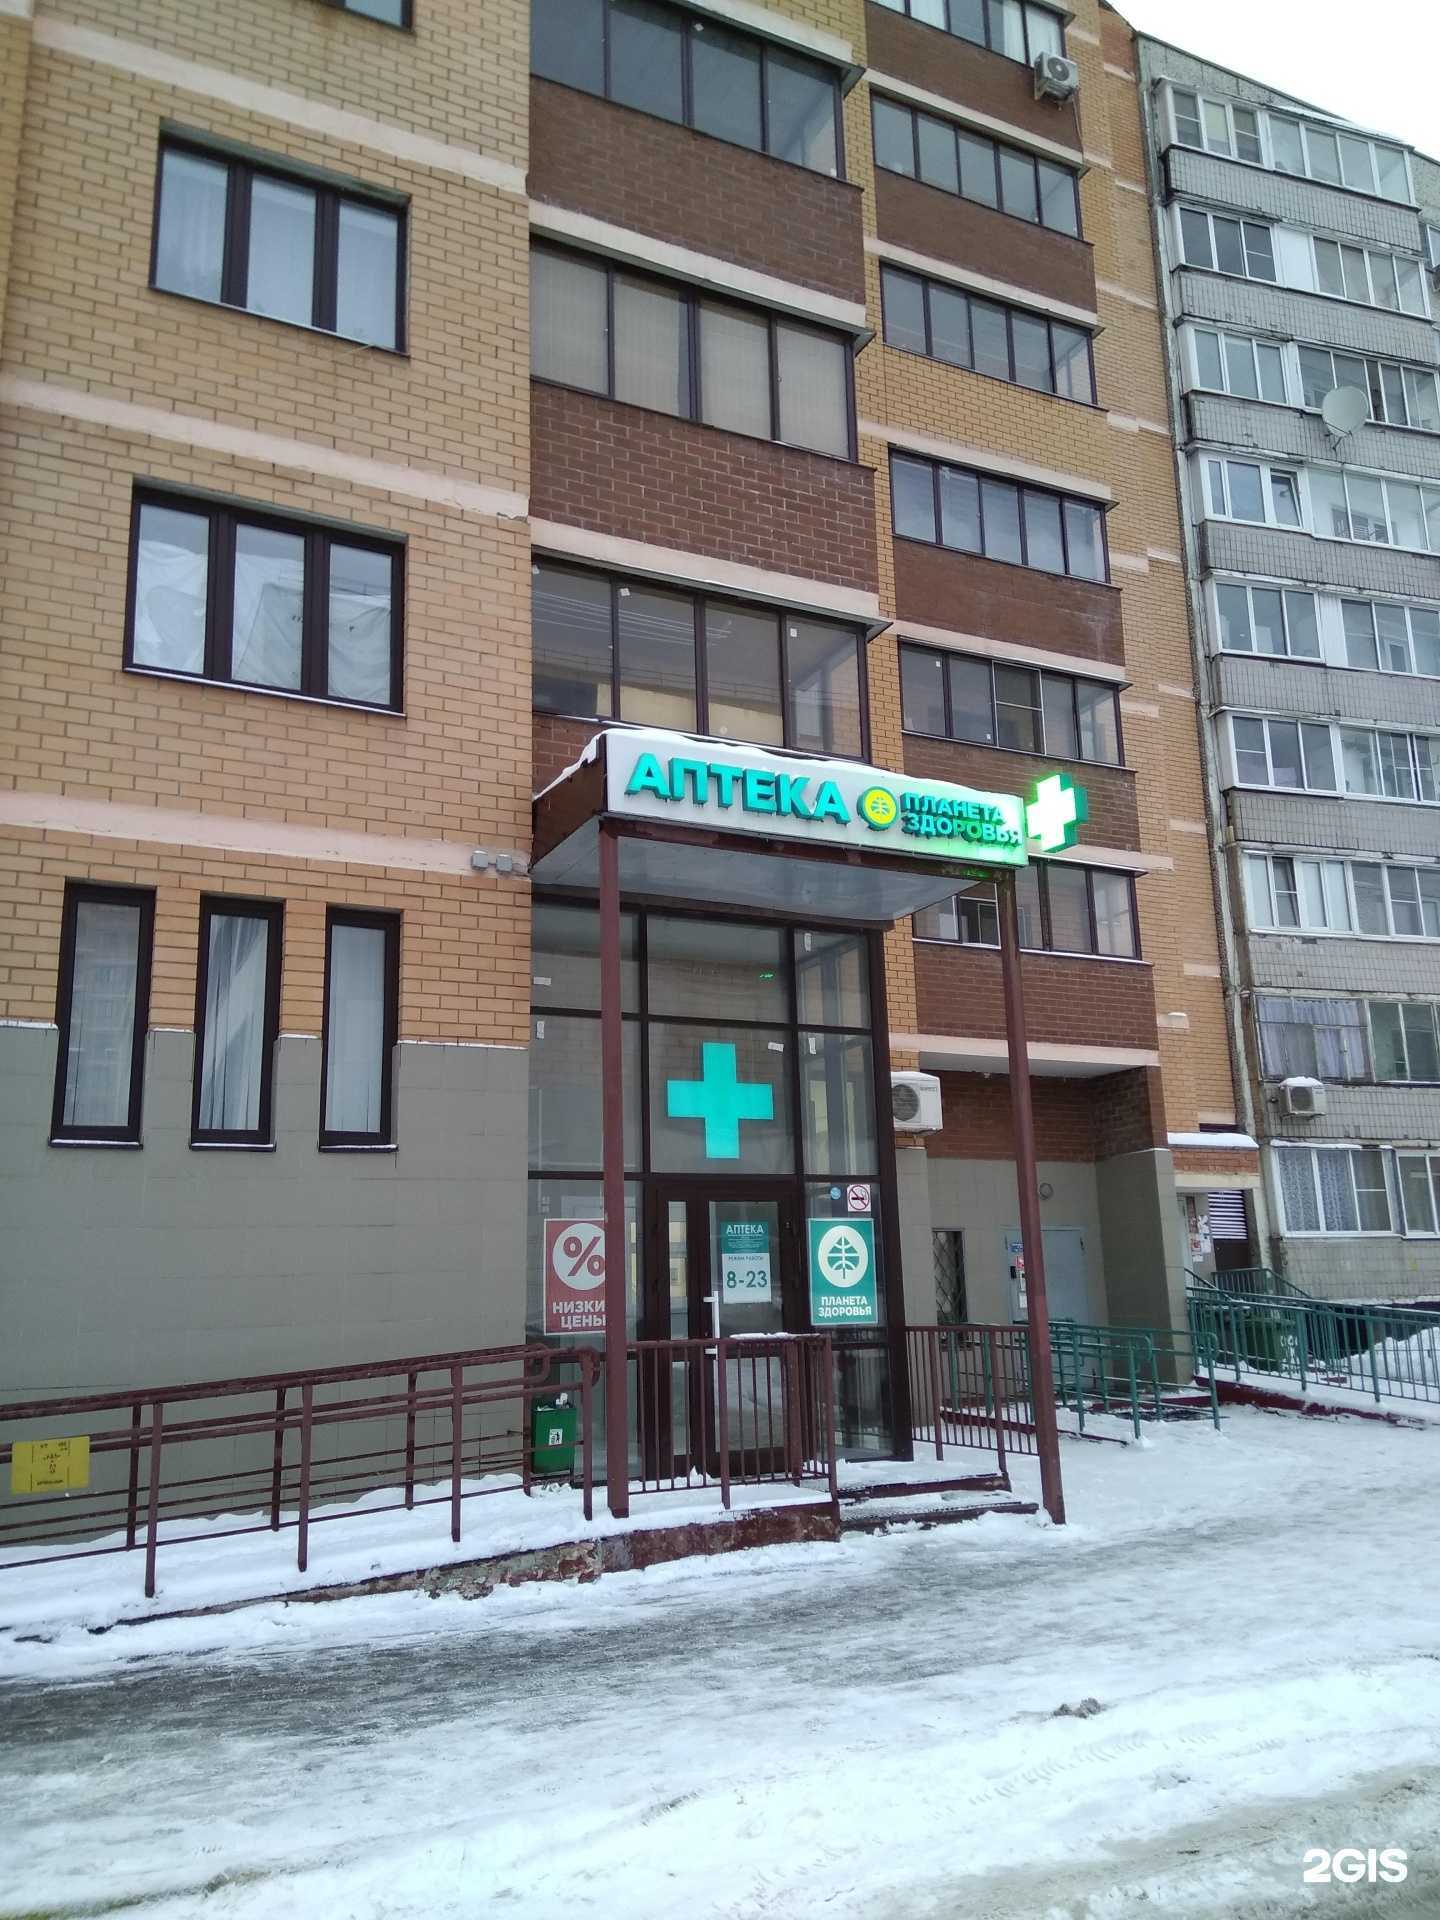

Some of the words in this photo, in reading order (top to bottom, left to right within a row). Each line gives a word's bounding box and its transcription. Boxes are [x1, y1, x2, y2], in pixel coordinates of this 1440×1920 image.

[625, 752, 852, 826] АПТЕКА
[900, 792, 1005, 824] ПЛАНЕТА
[902, 812, 1022, 846] ЗДОРОВЬЯ
[726, 1224, 764, 1234] АПТЕКА
[726, 1270, 768, 1289] 8-23
[552, 1301, 606, 1313] НИЗКИ
[821, 1296, 868, 1306] ПЛАНЕТА
[818, 1306, 872, 1318] ЗДОРОВЬЯ
[561, 1315, 606, 1329] ЦЕНЫ
